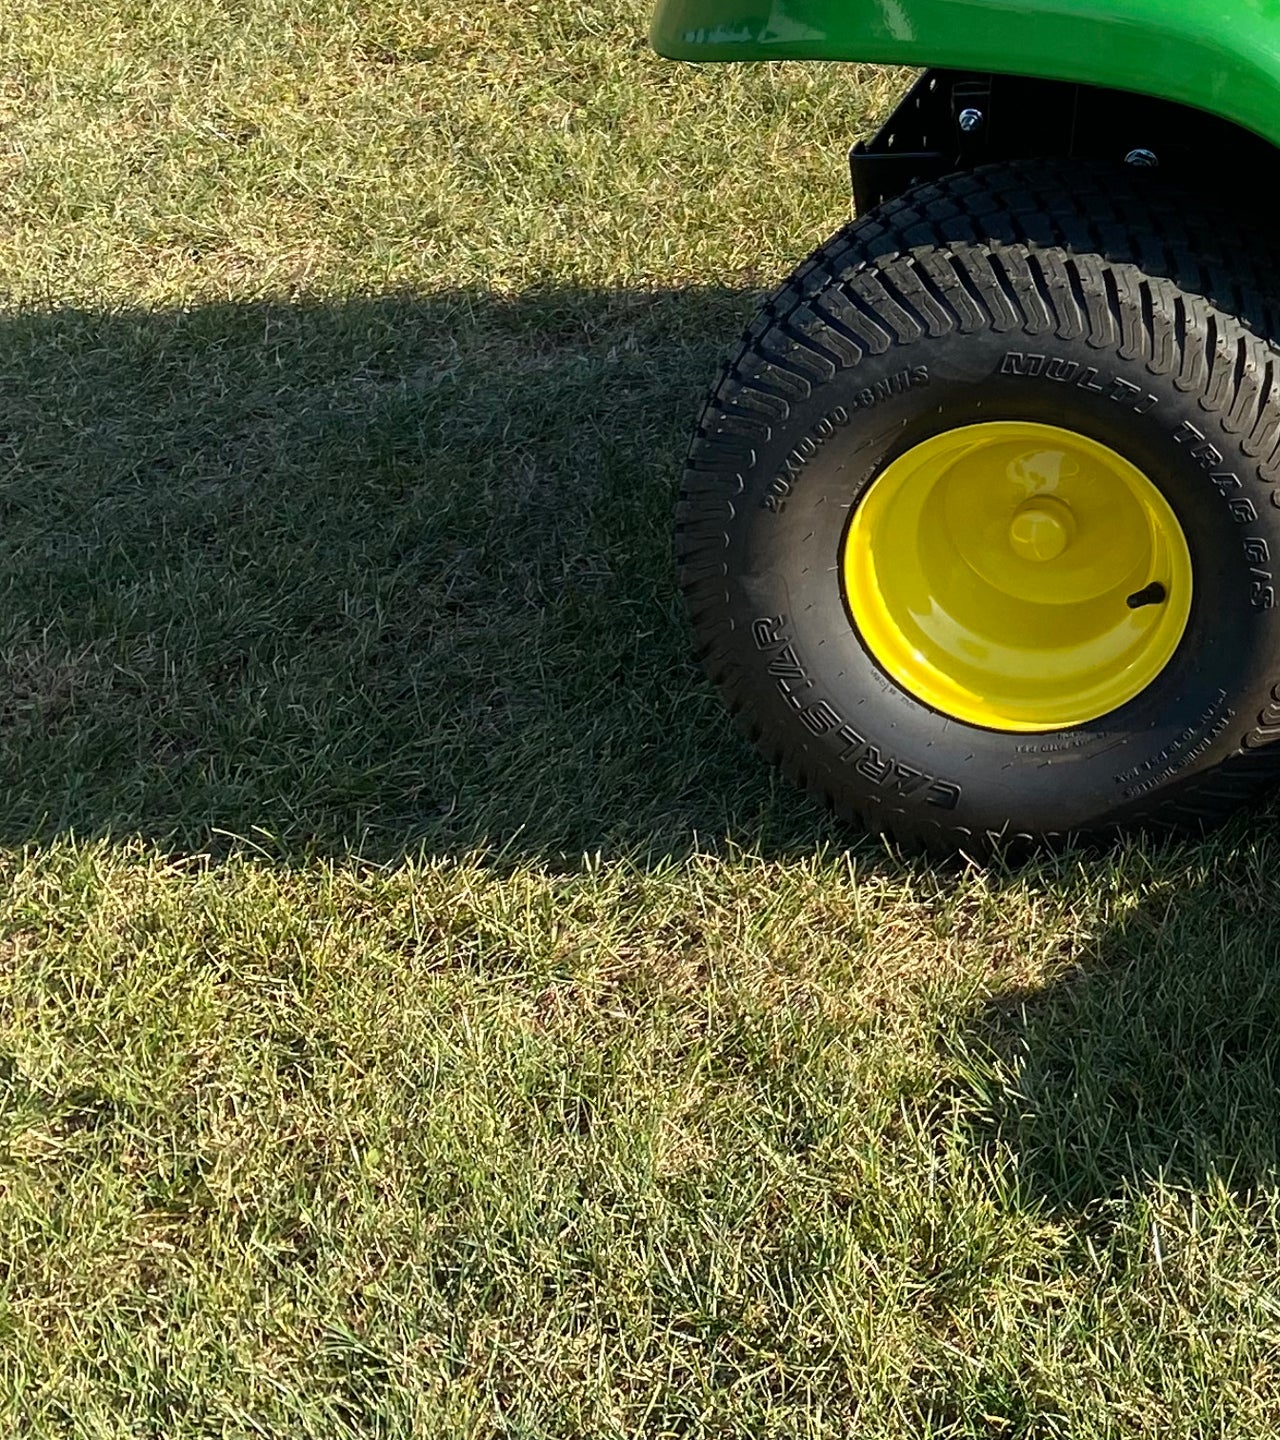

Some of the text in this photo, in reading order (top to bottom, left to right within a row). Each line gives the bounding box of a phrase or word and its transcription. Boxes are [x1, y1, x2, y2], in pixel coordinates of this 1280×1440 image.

[1000, 350, 1159, 414] MULTI
[1173, 419, 1258, 524] TRAC
[751, 614, 963, 811] CARLSTAR
